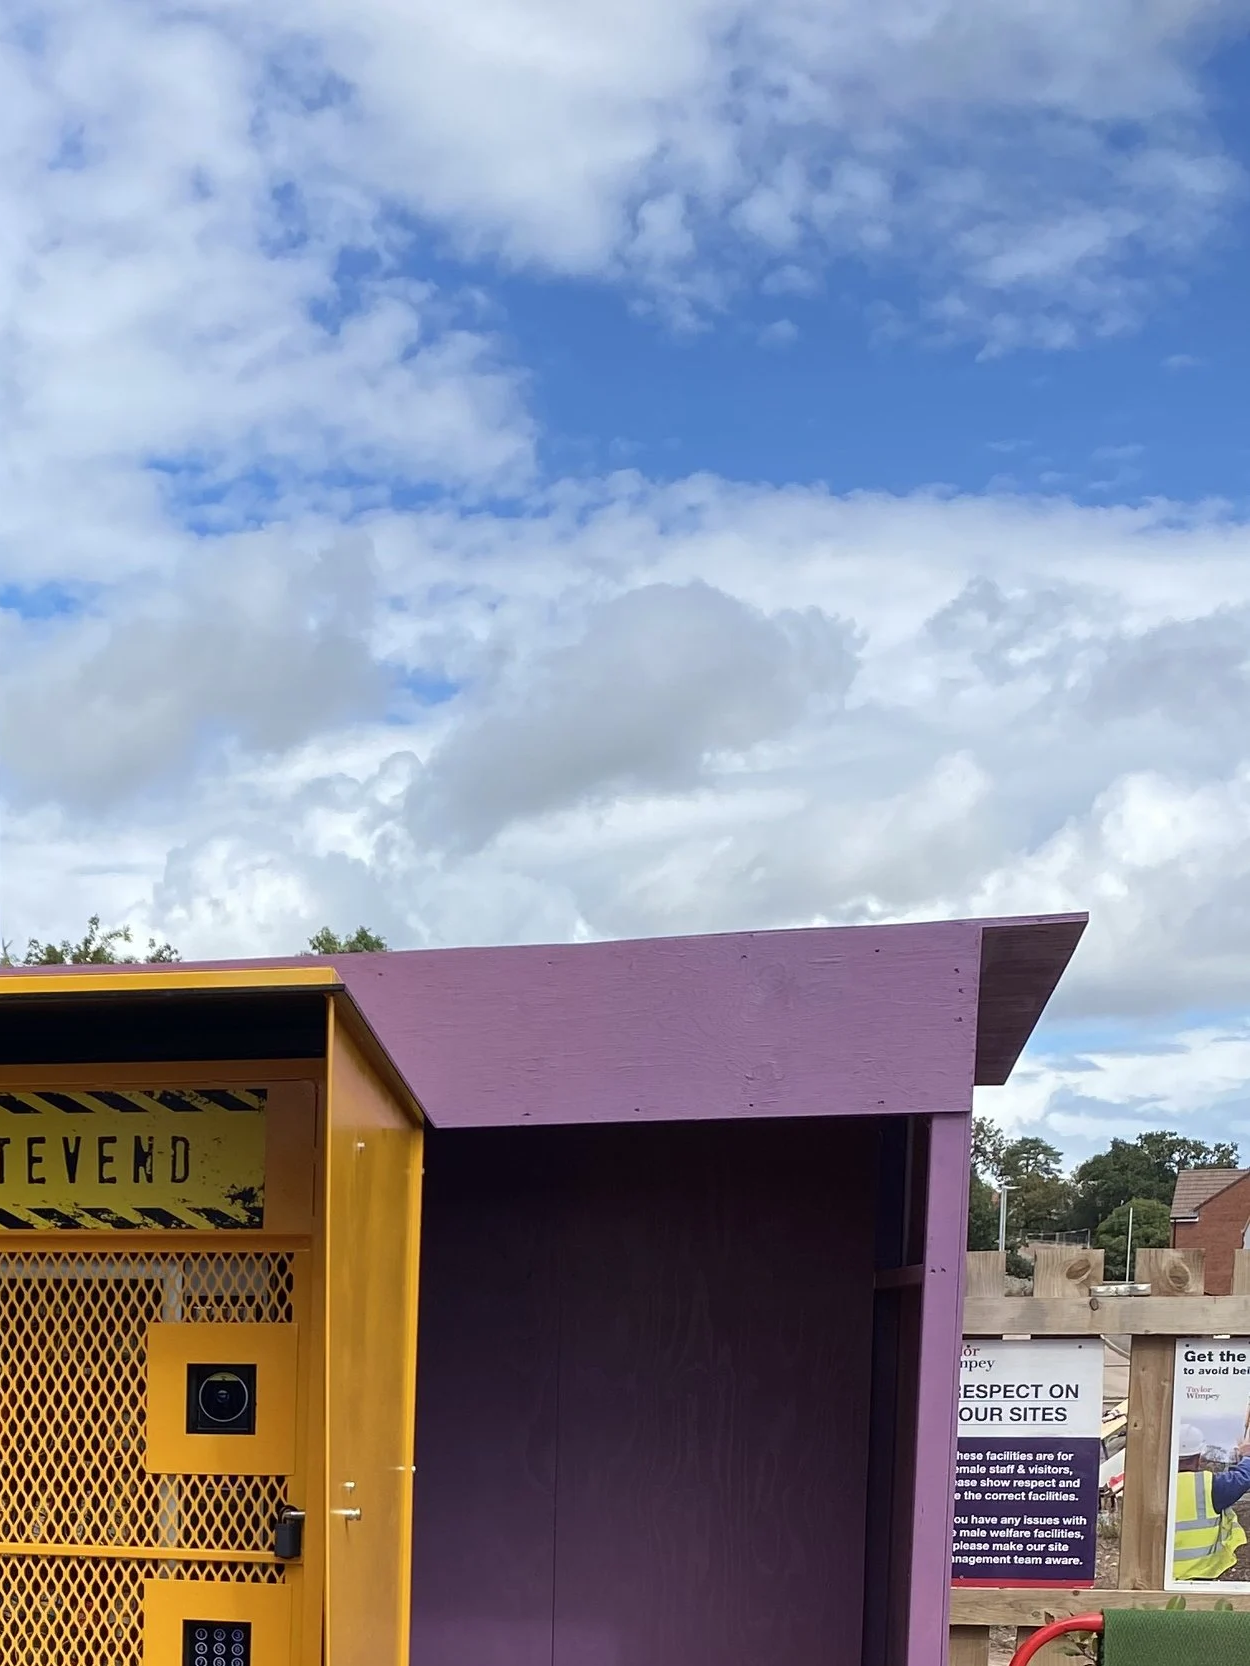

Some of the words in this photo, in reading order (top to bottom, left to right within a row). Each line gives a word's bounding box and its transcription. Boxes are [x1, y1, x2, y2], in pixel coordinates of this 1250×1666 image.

[1184, 1350, 1214, 1362] Get
[1219, 1351, 1246, 1362] the
[1049, 1384, 1079, 1399] ON
[959, 1407, 1002, 1422] OUR
[1010, 1407, 1067, 1422] SITES
[957, 1451, 983, 1461] hese
[986, 1451, 1033, 1461] facilities
[1057, 1452, 1074, 1461] for
[989, 1465, 1014, 1474] staff
[1017, 1465, 1026, 1474] &
[1028, 1465, 1073, 1476] visitors,
[980, 1478, 1010, 1487] show
[1013, 1479, 1056, 1489] respect
[1059, 1478, 1080, 1488] and
[964, 1491, 982, 1500] the
[985, 1492, 1026, 1501] correct
[1028, 1491, 1078, 1501] facilities.
[971, 1515, 998, 1524] have
[1000, 1517, 1020, 1526] any
[1023, 1516, 1060, 1525] issues
[1063, 1516, 1086, 1525] with
[960, 1528, 987, 1537] male
[990, 1528, 1031, 1538] welfare
[1033, 1529, 1084, 1540] facilities,
[953, 1541, 989, 1551] please
[992, 1542, 1023, 1551] make
[1048, 1543, 1069, 1551] site
[1014, 1556, 1042, 1564] team
[1045, 1556, 1083, 1565] aware.
